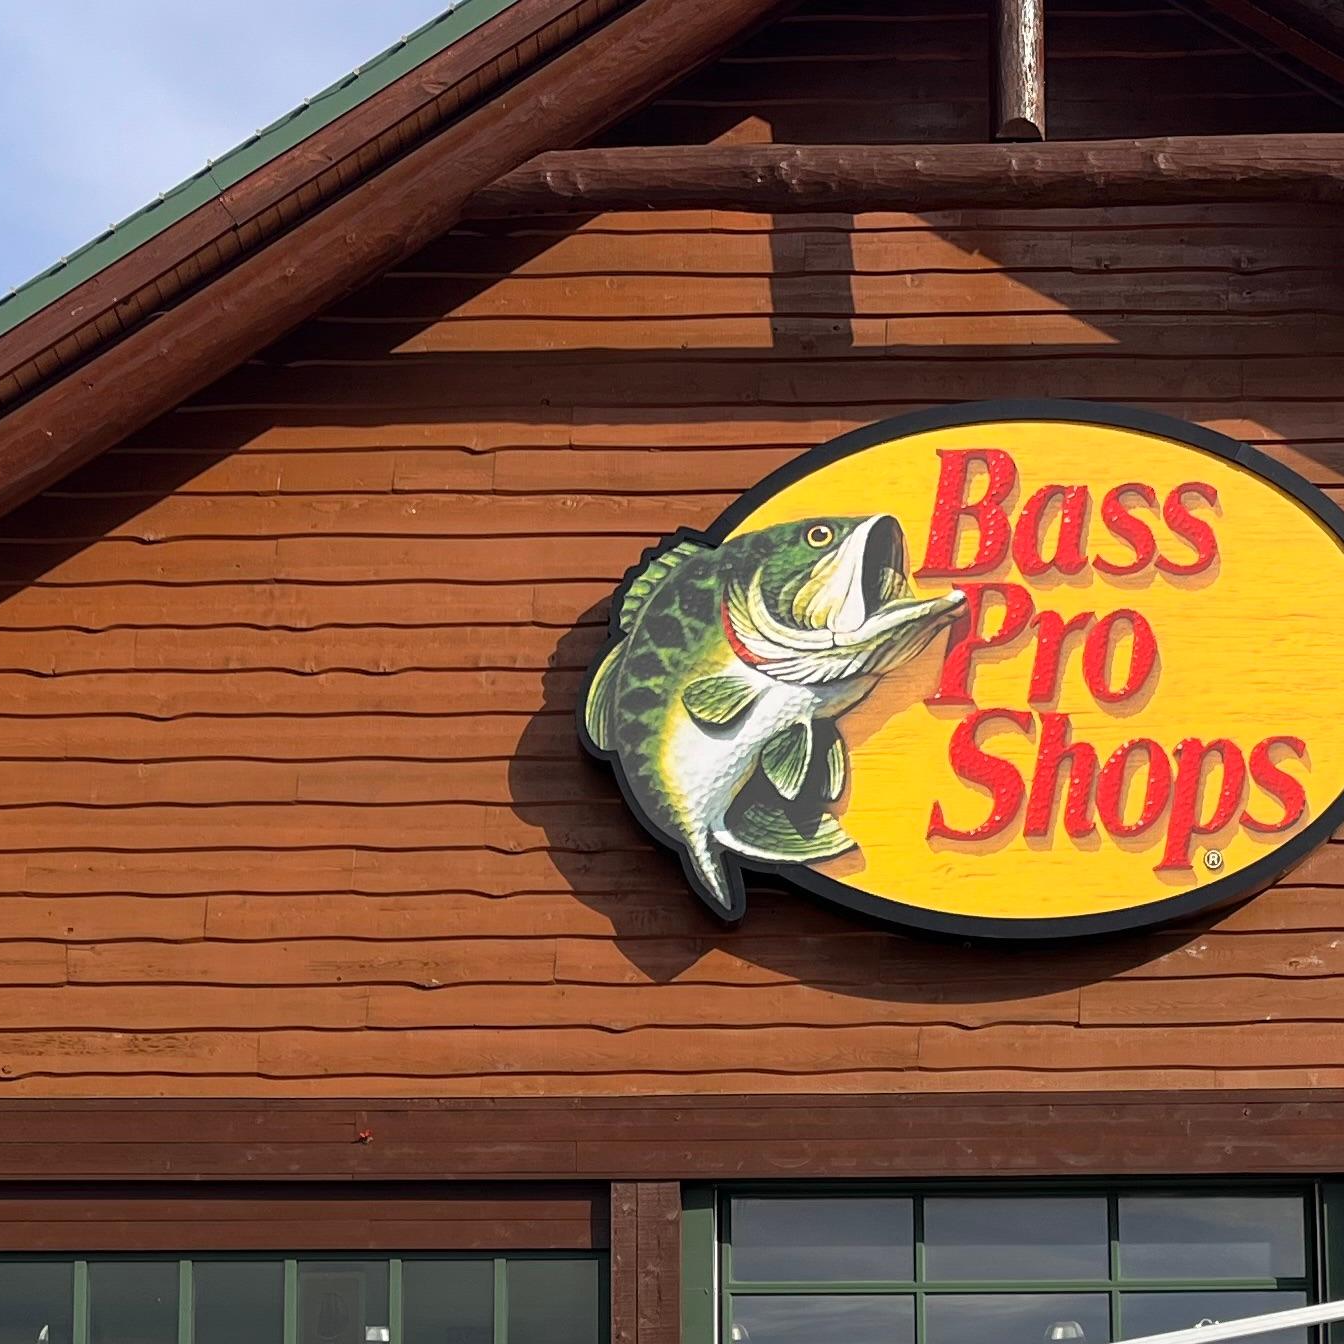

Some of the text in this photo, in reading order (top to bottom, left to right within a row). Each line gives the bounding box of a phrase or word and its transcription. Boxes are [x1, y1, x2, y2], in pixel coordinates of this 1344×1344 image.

[913, 447, 1220, 578] Bass
[925, 582, 1160, 706] Pro
[926, 708, 1308, 872] Shops
